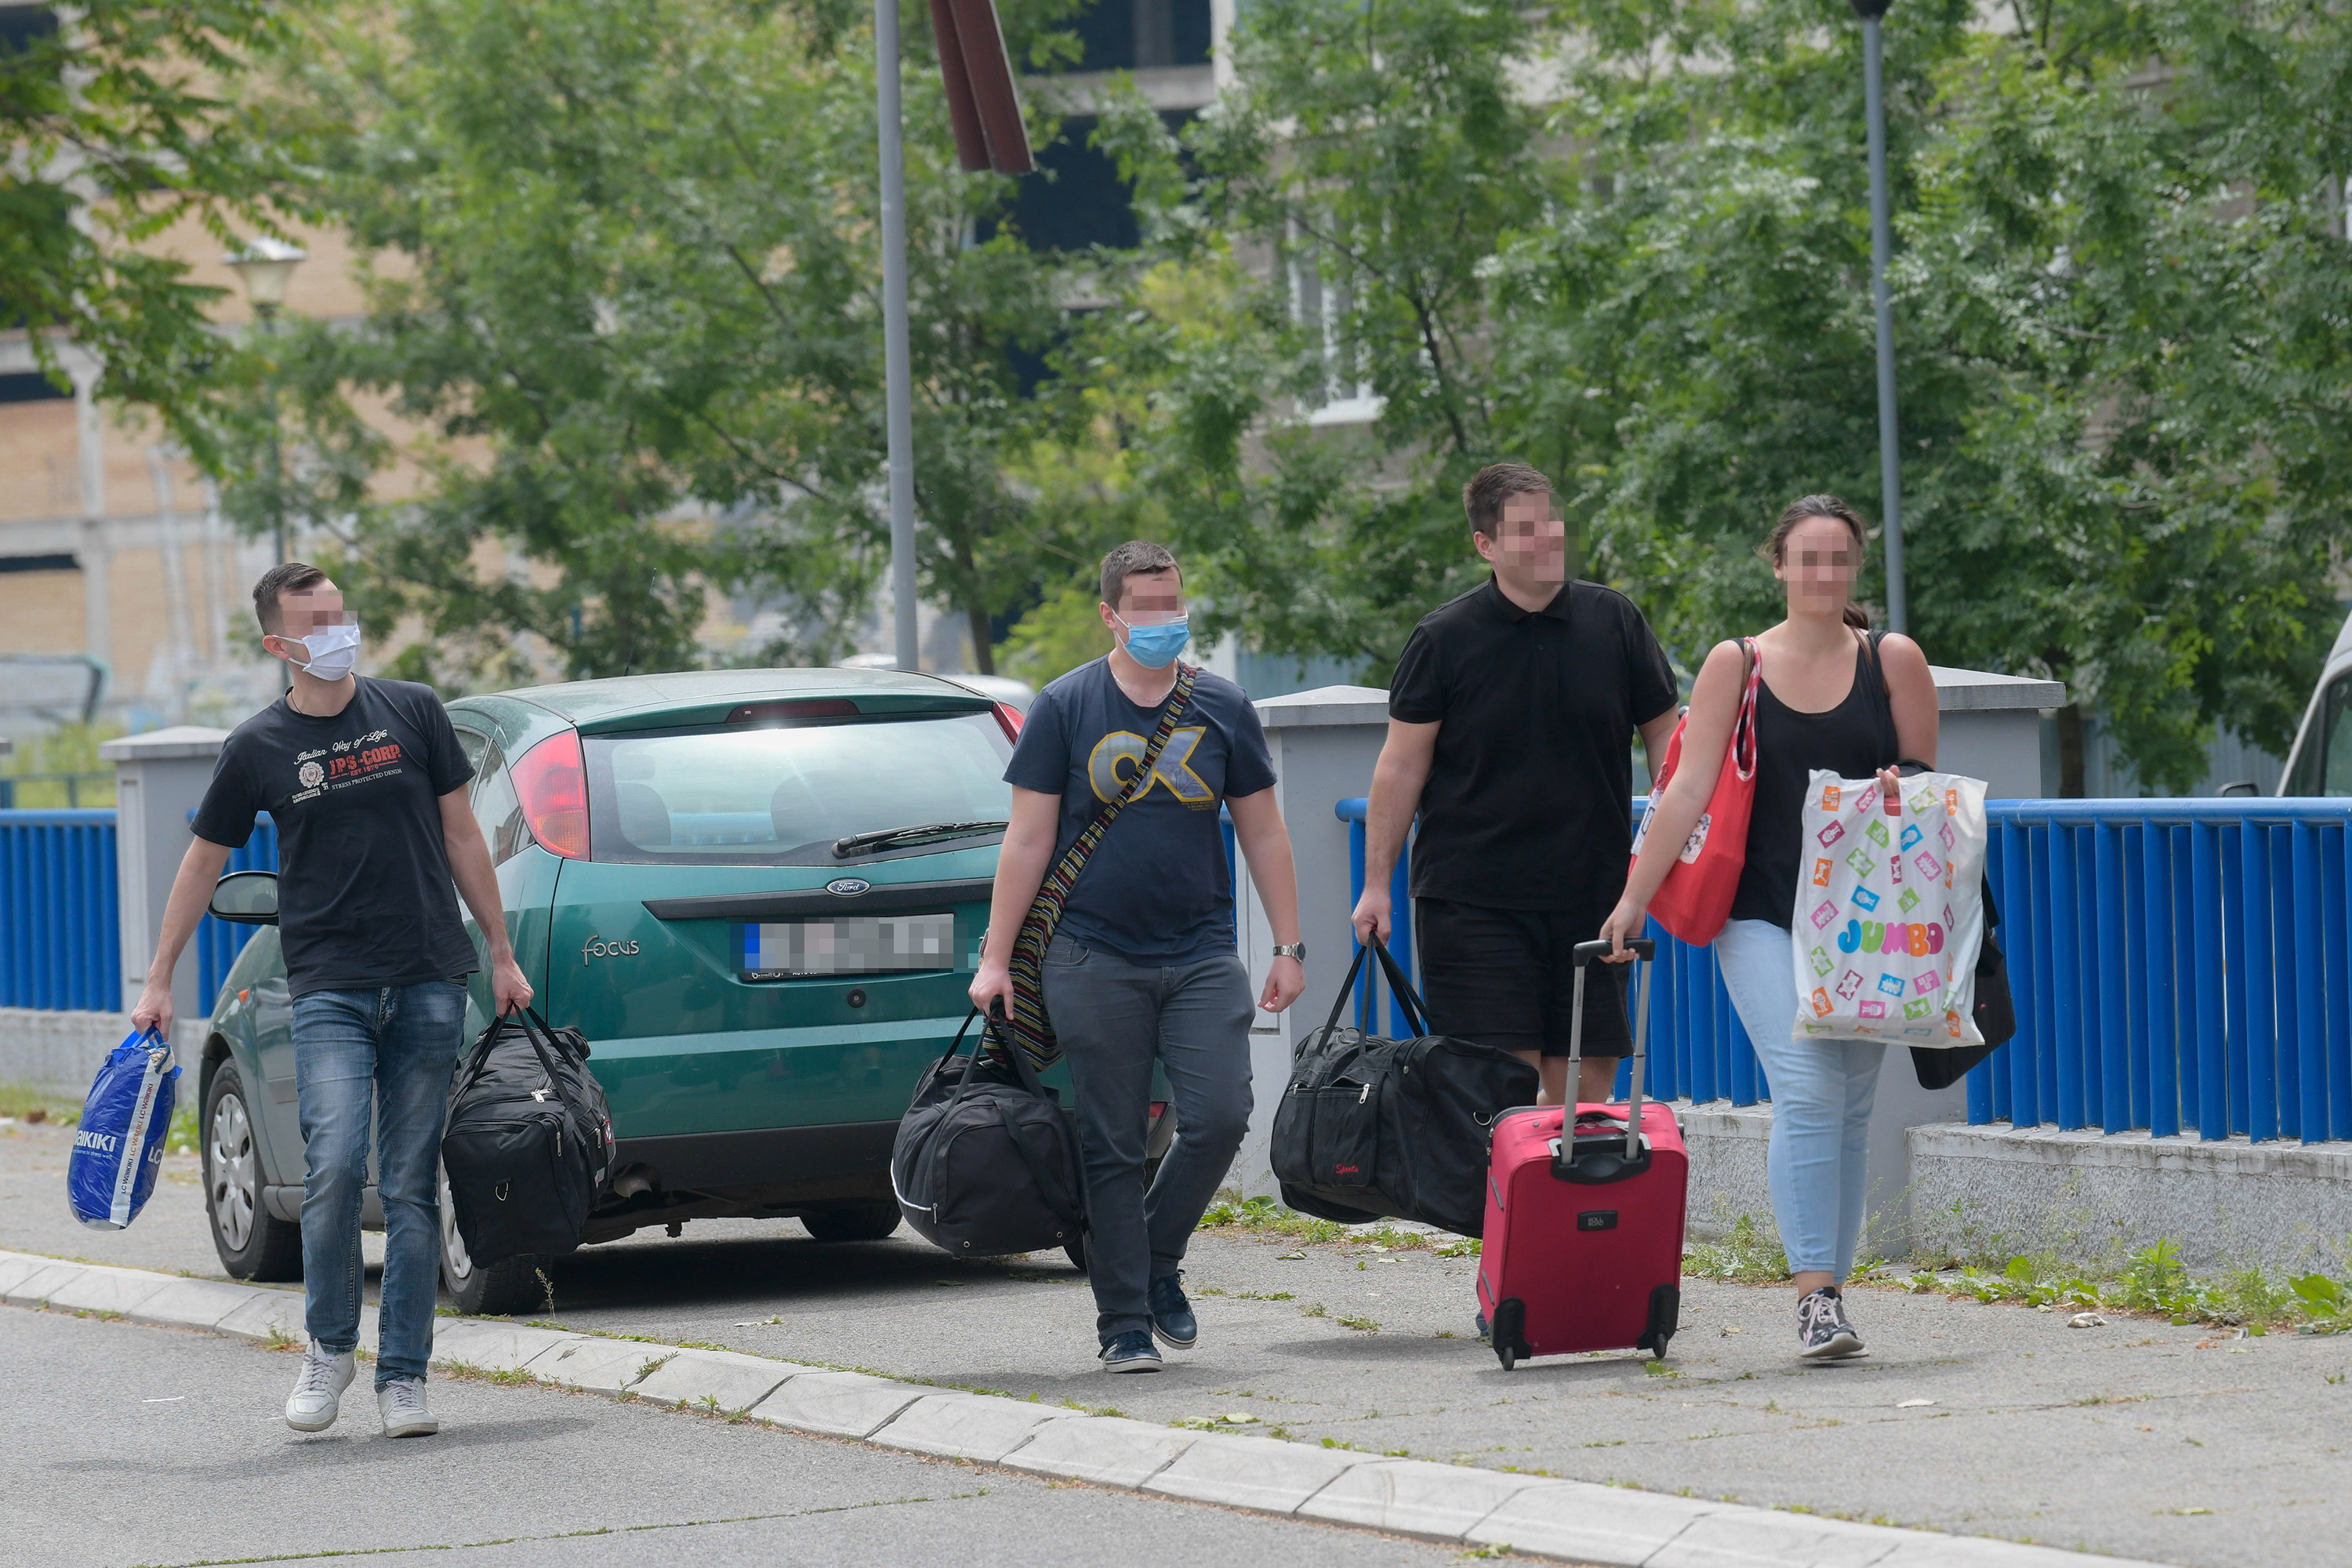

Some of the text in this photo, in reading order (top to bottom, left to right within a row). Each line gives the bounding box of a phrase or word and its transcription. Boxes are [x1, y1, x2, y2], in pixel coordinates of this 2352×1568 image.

[294, 729, 387, 765] Italian Way of Life
[350, 768, 363, 776] EST.
[331, 781, 352, 790] STRESS
[351, 773, 383, 786] PROTECTED
[383, 768, 402, 777] DENIM
[837, 882, 860, 891] Ford
[1838, 919, 1944, 957] JUMBO
[139, 1109, 146, 1120] LC
[129, 1147, 136, 1156] LC
[147, 1146, 162, 1164] LC
[1335, 1163, 1359, 1174] Sports
[121, 1185, 127, 1194] LC
